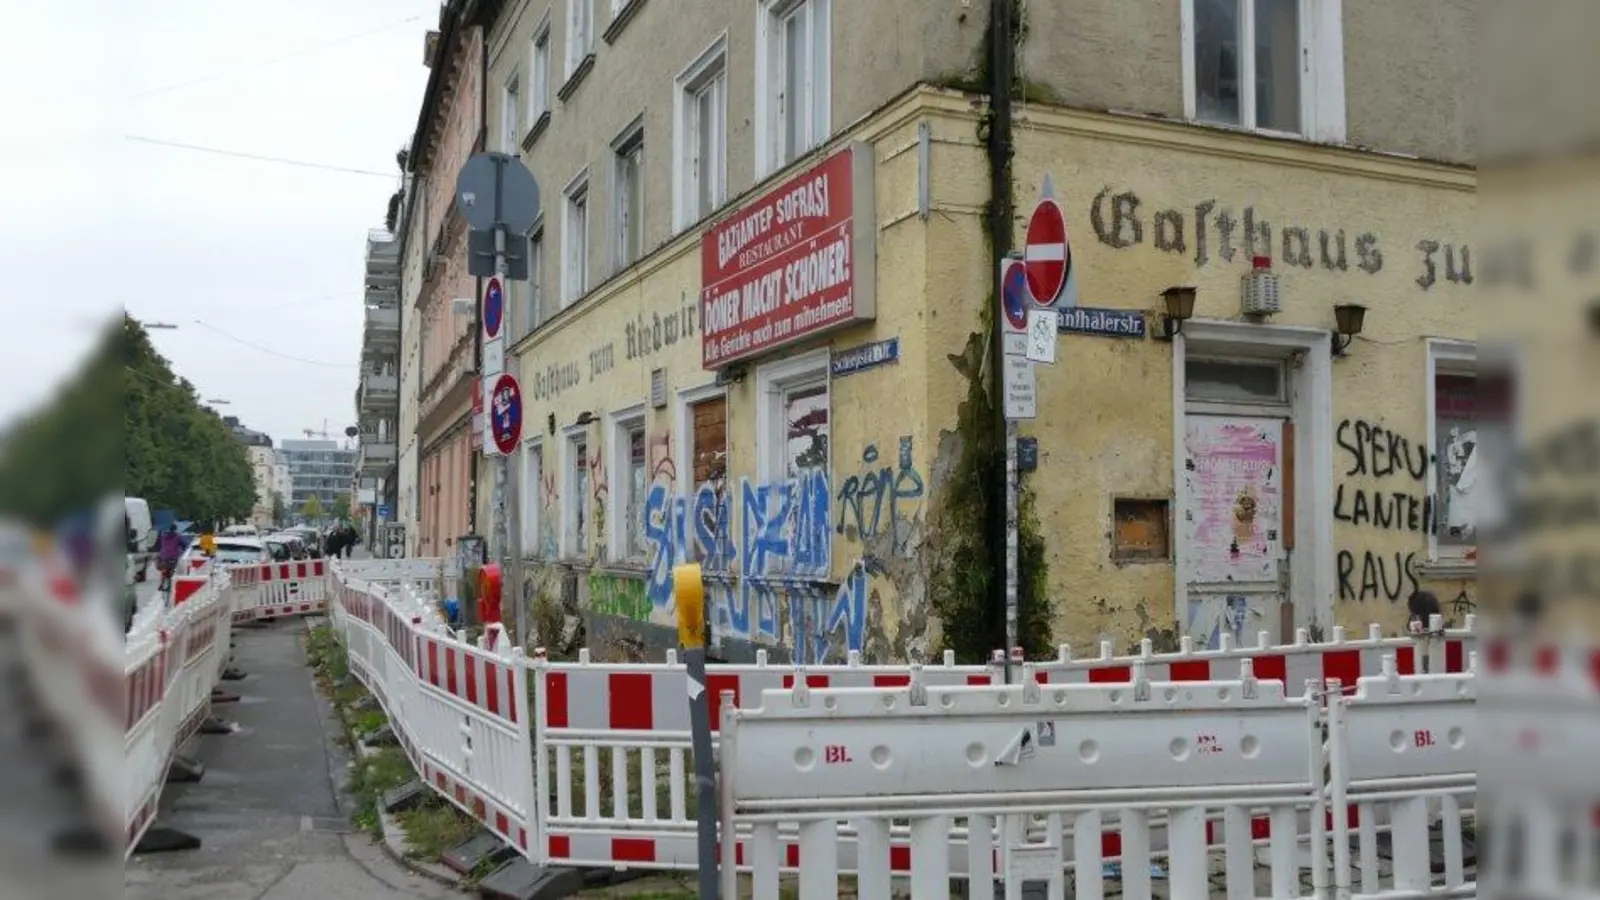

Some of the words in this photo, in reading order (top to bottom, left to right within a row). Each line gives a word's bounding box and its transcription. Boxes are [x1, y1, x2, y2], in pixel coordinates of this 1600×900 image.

[738, 221, 804, 268] RESTAURANT
[742, 268, 783, 319] MACHT
[705, 339, 719, 362] Alle
[720, 328, 751, 358] Gerichte
[752, 318, 773, 344] auch
[774, 317, 791, 339] zum
[793, 287, 853, 330] mitnehmen!
[1337, 550, 1420, 602] RAUS
[825, 745, 852, 764] BL
[1415, 730, 1436, 747] BL
